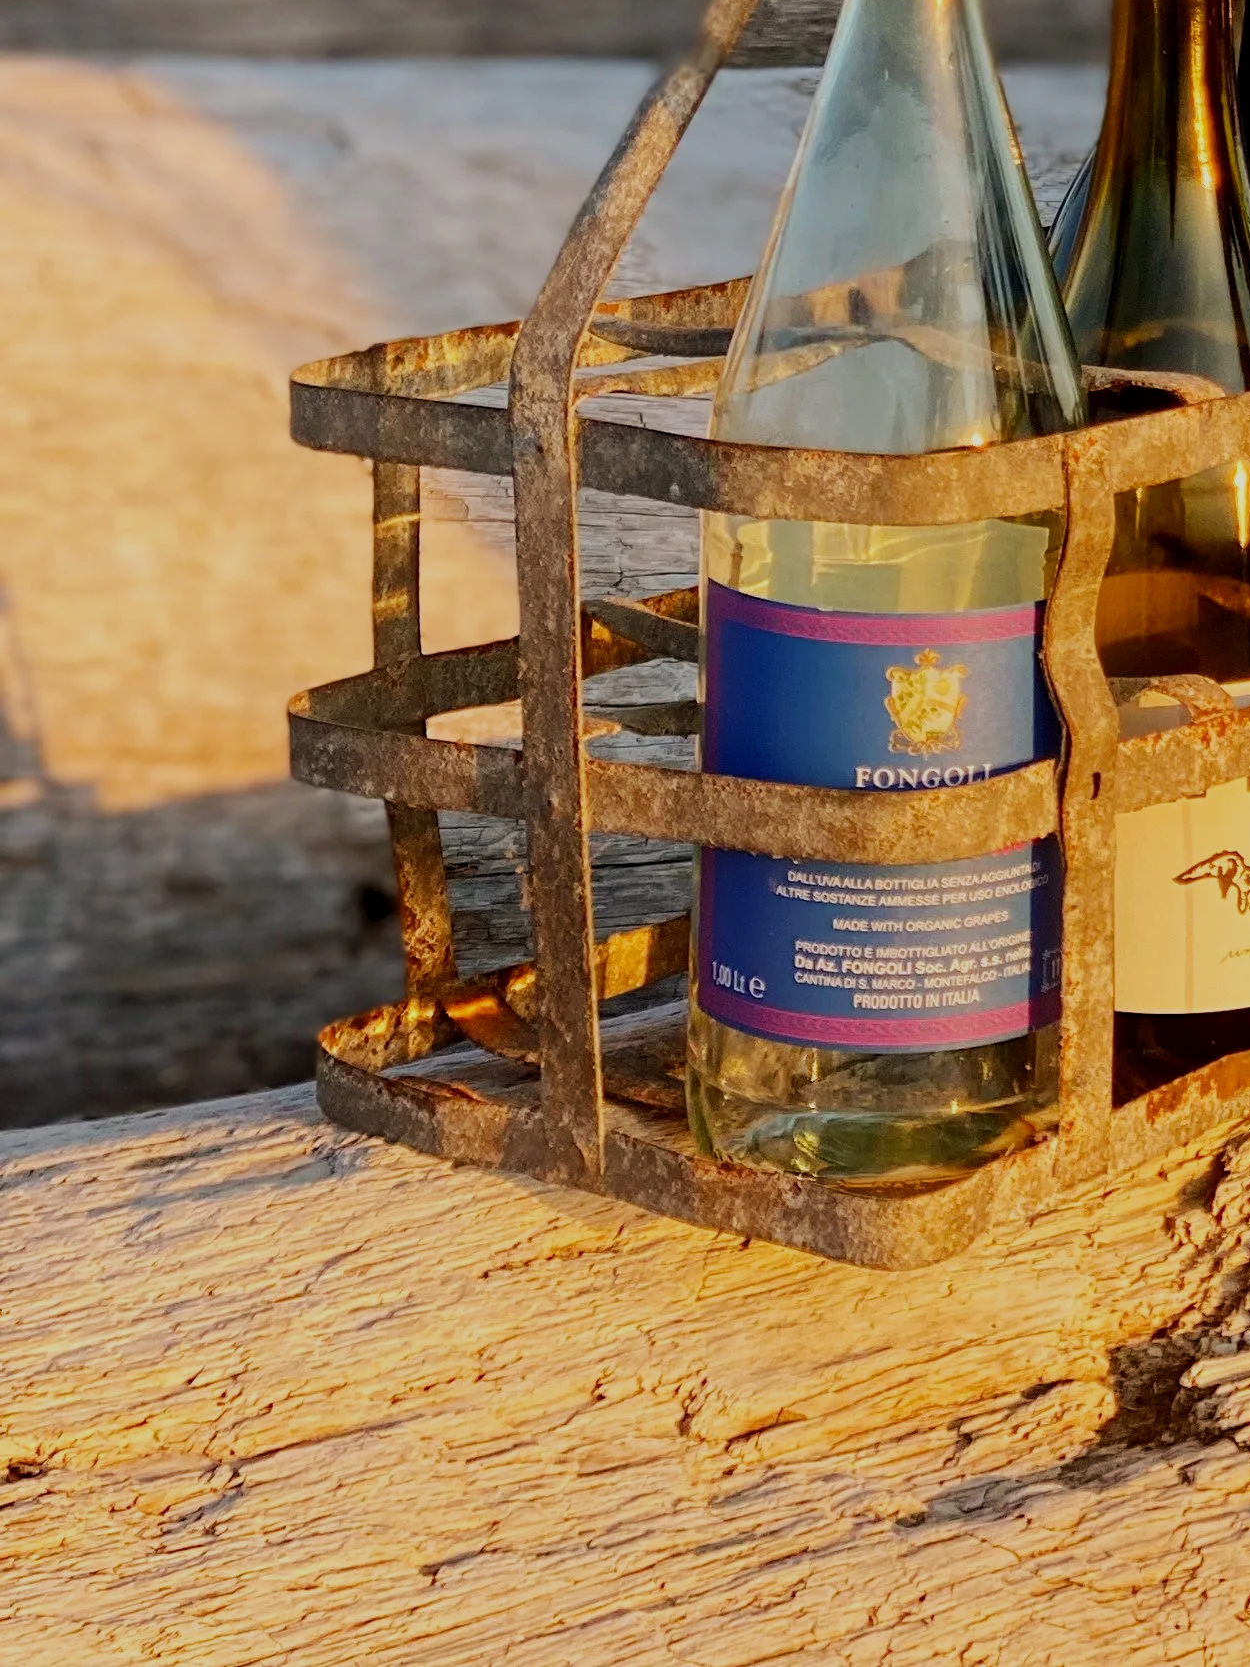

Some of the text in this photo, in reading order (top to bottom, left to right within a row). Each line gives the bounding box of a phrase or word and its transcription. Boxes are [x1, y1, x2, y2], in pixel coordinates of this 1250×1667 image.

[841, 877, 873, 890] ALLA
[874, 879, 938, 891] BOTTIGLIA
[941, 875, 980, 889] SENZA
[980, 863, 1031, 884] AGGIUNTA
[776, 885, 811, 901] ALTRE
[812, 891, 877, 906] SOSTANZE
[878, 894, 940, 907] AMMESSE
[942, 892, 967, 905] PER
[969, 888, 993, 902] USO
[832, 910, 1009, 932] MADE WITH ORGANIC GRAPES
[795, 940, 861, 958] PRODOTTO
[864, 946, 874, 959] E
[876, 943, 967, 959] IMBOTTIGLIATO
[794, 954, 813, 970] Da
[815, 957, 839, 973] Az.
[842, 961, 912, 975] FONGOLI
[914, 961, 947, 975] Soc.
[949, 957, 977, 975] Agr.
[794, 972, 843, 988] CANTINA
[844, 976, 856, 989] DI
[858, 978, 870, 990] S.
[872, 978, 915, 990] MARCO
[924, 970, 996, 990] MONTEFALCO
[1003, 960, 1031, 979] ITALIA
[854, 988, 980, 1010] PRODOTTO IN ITALIA
